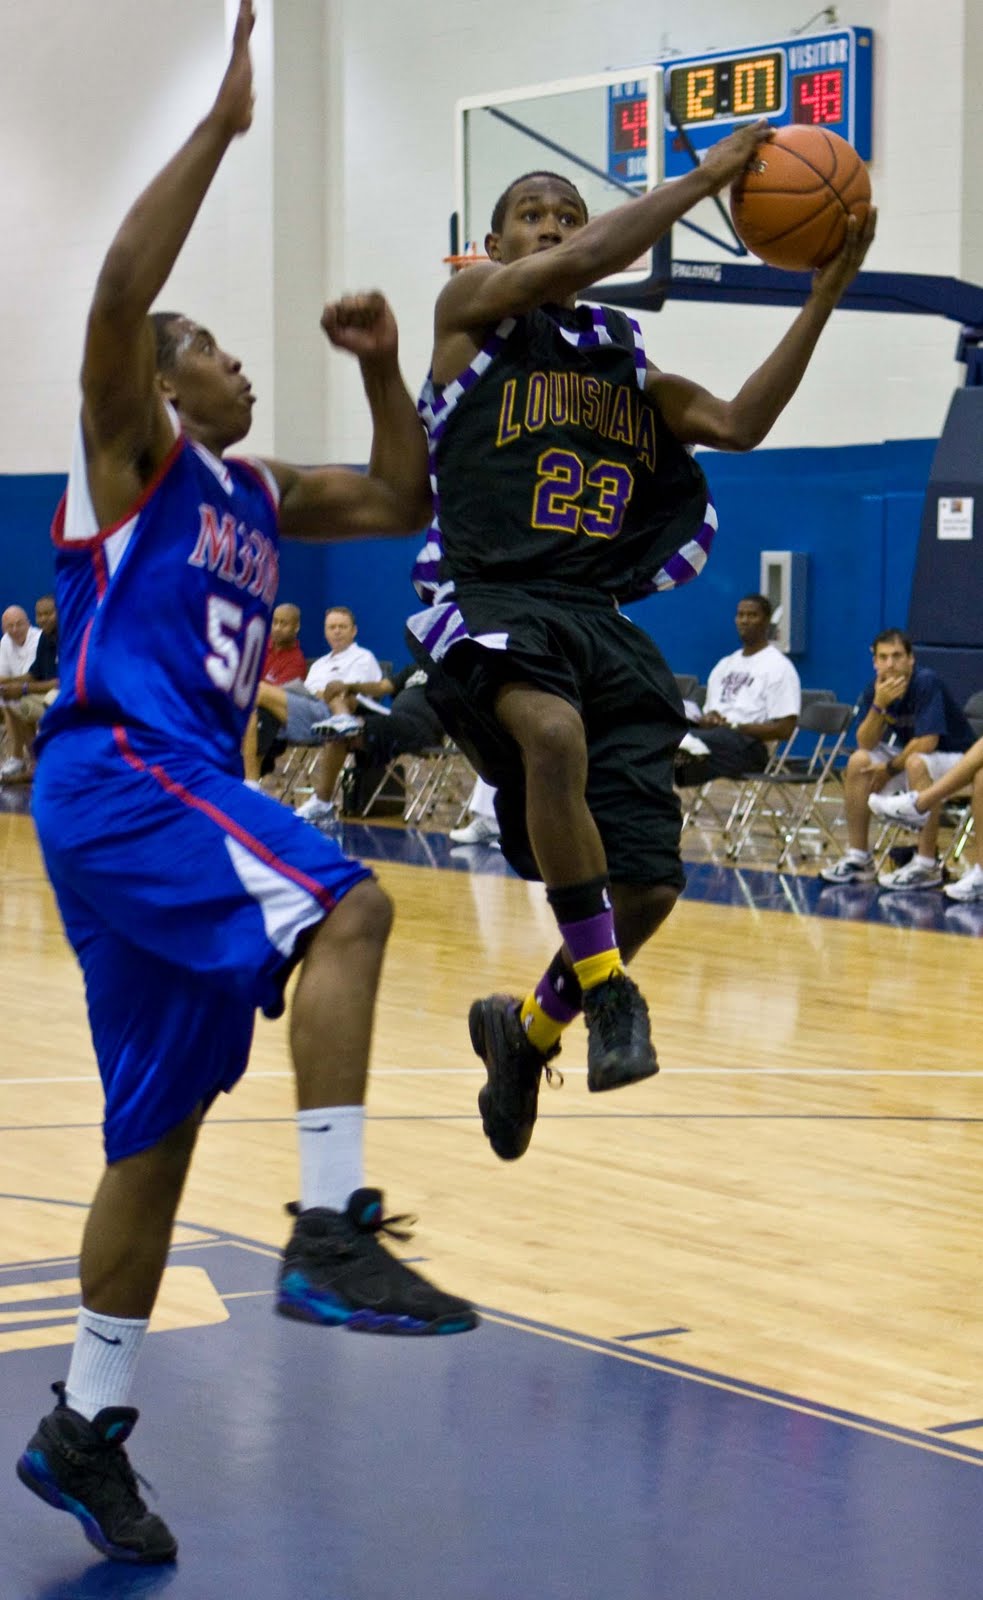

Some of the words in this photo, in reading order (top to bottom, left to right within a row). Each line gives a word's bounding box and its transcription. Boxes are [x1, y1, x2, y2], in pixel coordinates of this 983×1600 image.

[789, 39, 848, 70] VISITOR
[496, 371, 657, 473] LOUISIAA
[531, 447, 635, 541] 23
[204, 594, 267, 711] 50
